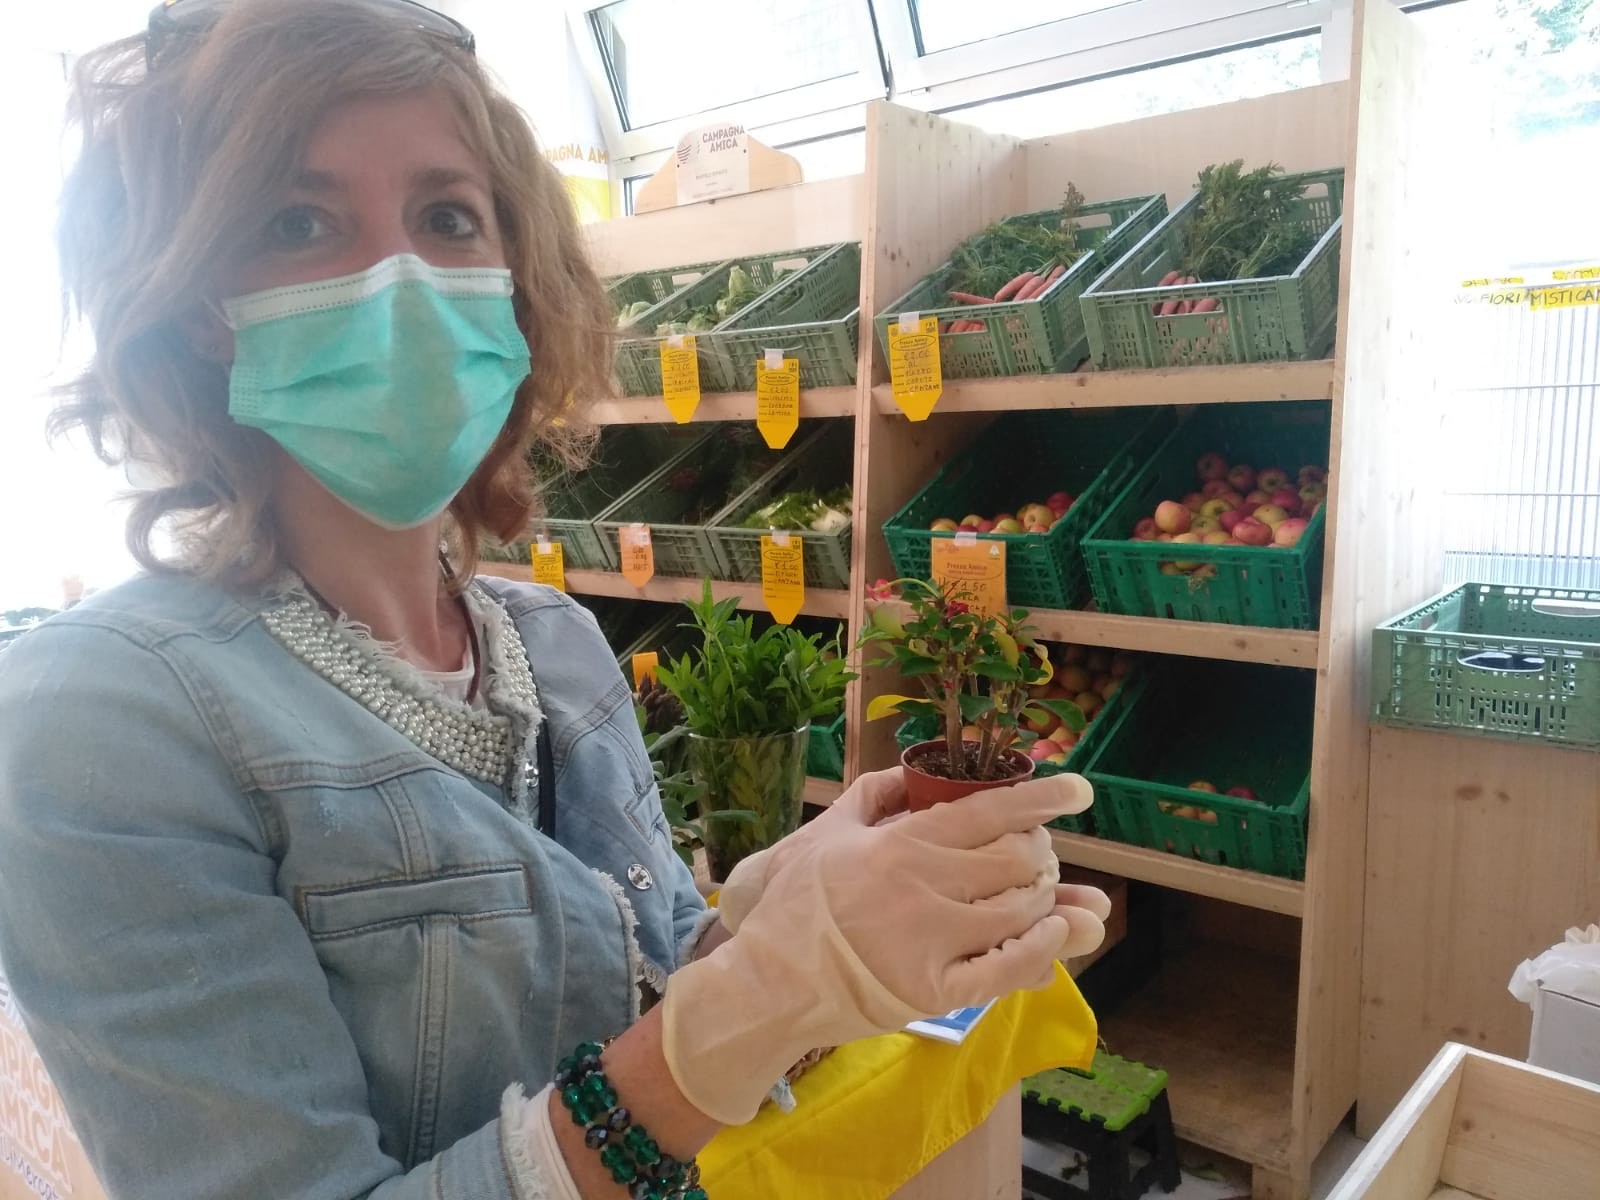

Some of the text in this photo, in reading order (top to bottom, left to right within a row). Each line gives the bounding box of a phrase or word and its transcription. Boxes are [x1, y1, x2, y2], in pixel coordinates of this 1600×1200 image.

[702, 124, 745, 144] CAMPAGNA
[544, 143, 583, 161] PAGNA
[710, 138, 738, 153] AMICA
[1480, 292, 1521, 305] FIORI
